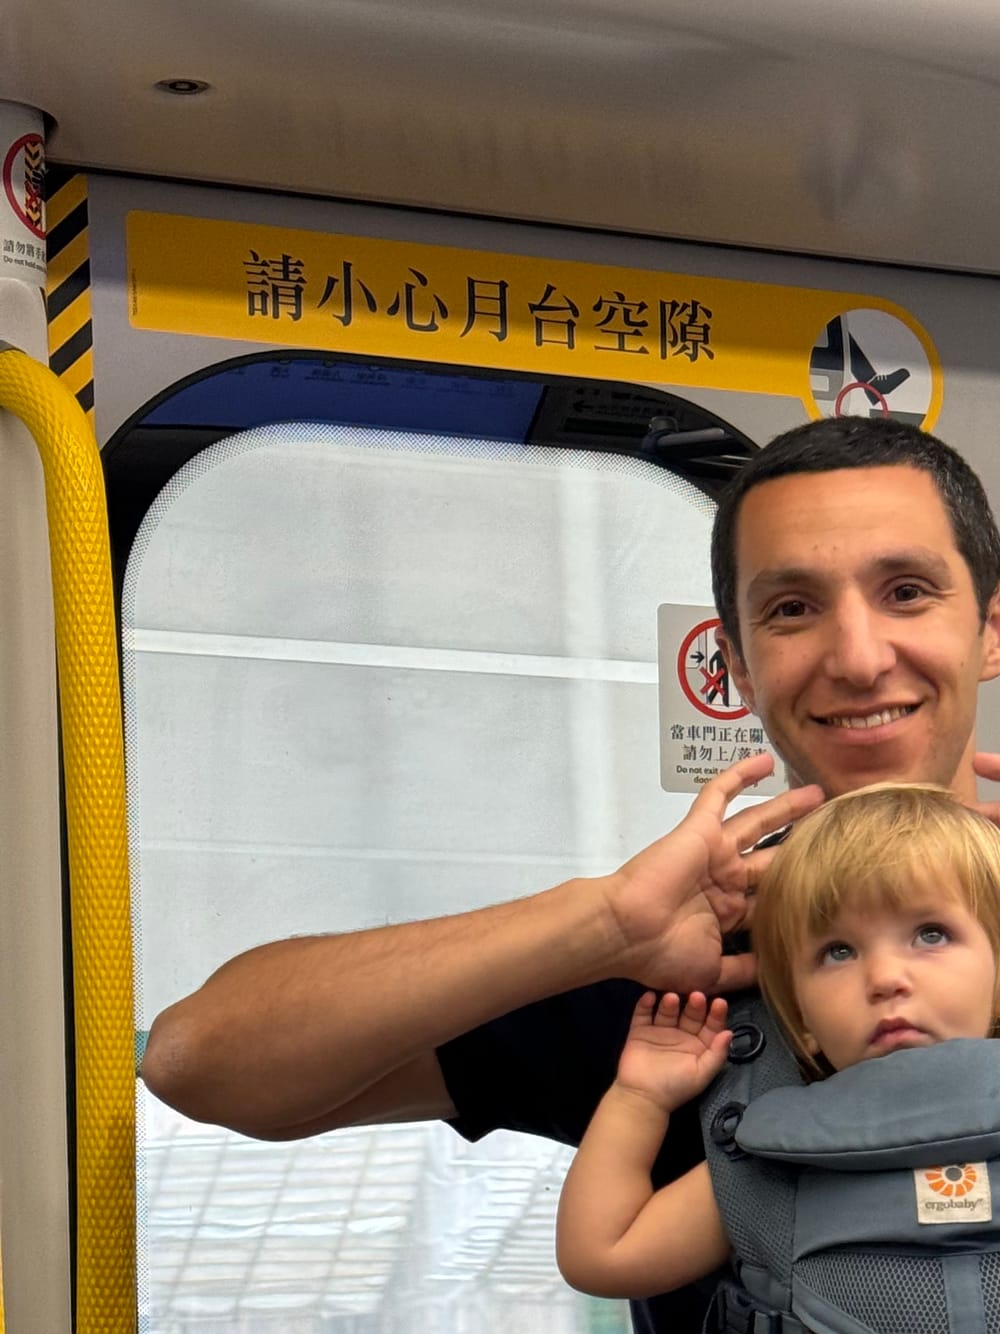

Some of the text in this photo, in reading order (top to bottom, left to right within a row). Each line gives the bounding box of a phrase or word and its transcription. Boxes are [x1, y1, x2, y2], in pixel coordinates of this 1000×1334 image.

[242, 249, 715, 362] 請小心月台空隙
[671, 724, 769, 744] 當車門正在關
[676, 765, 687, 774] Do
[689, 766, 702, 774] not
[704, 766, 718, 775] exit
